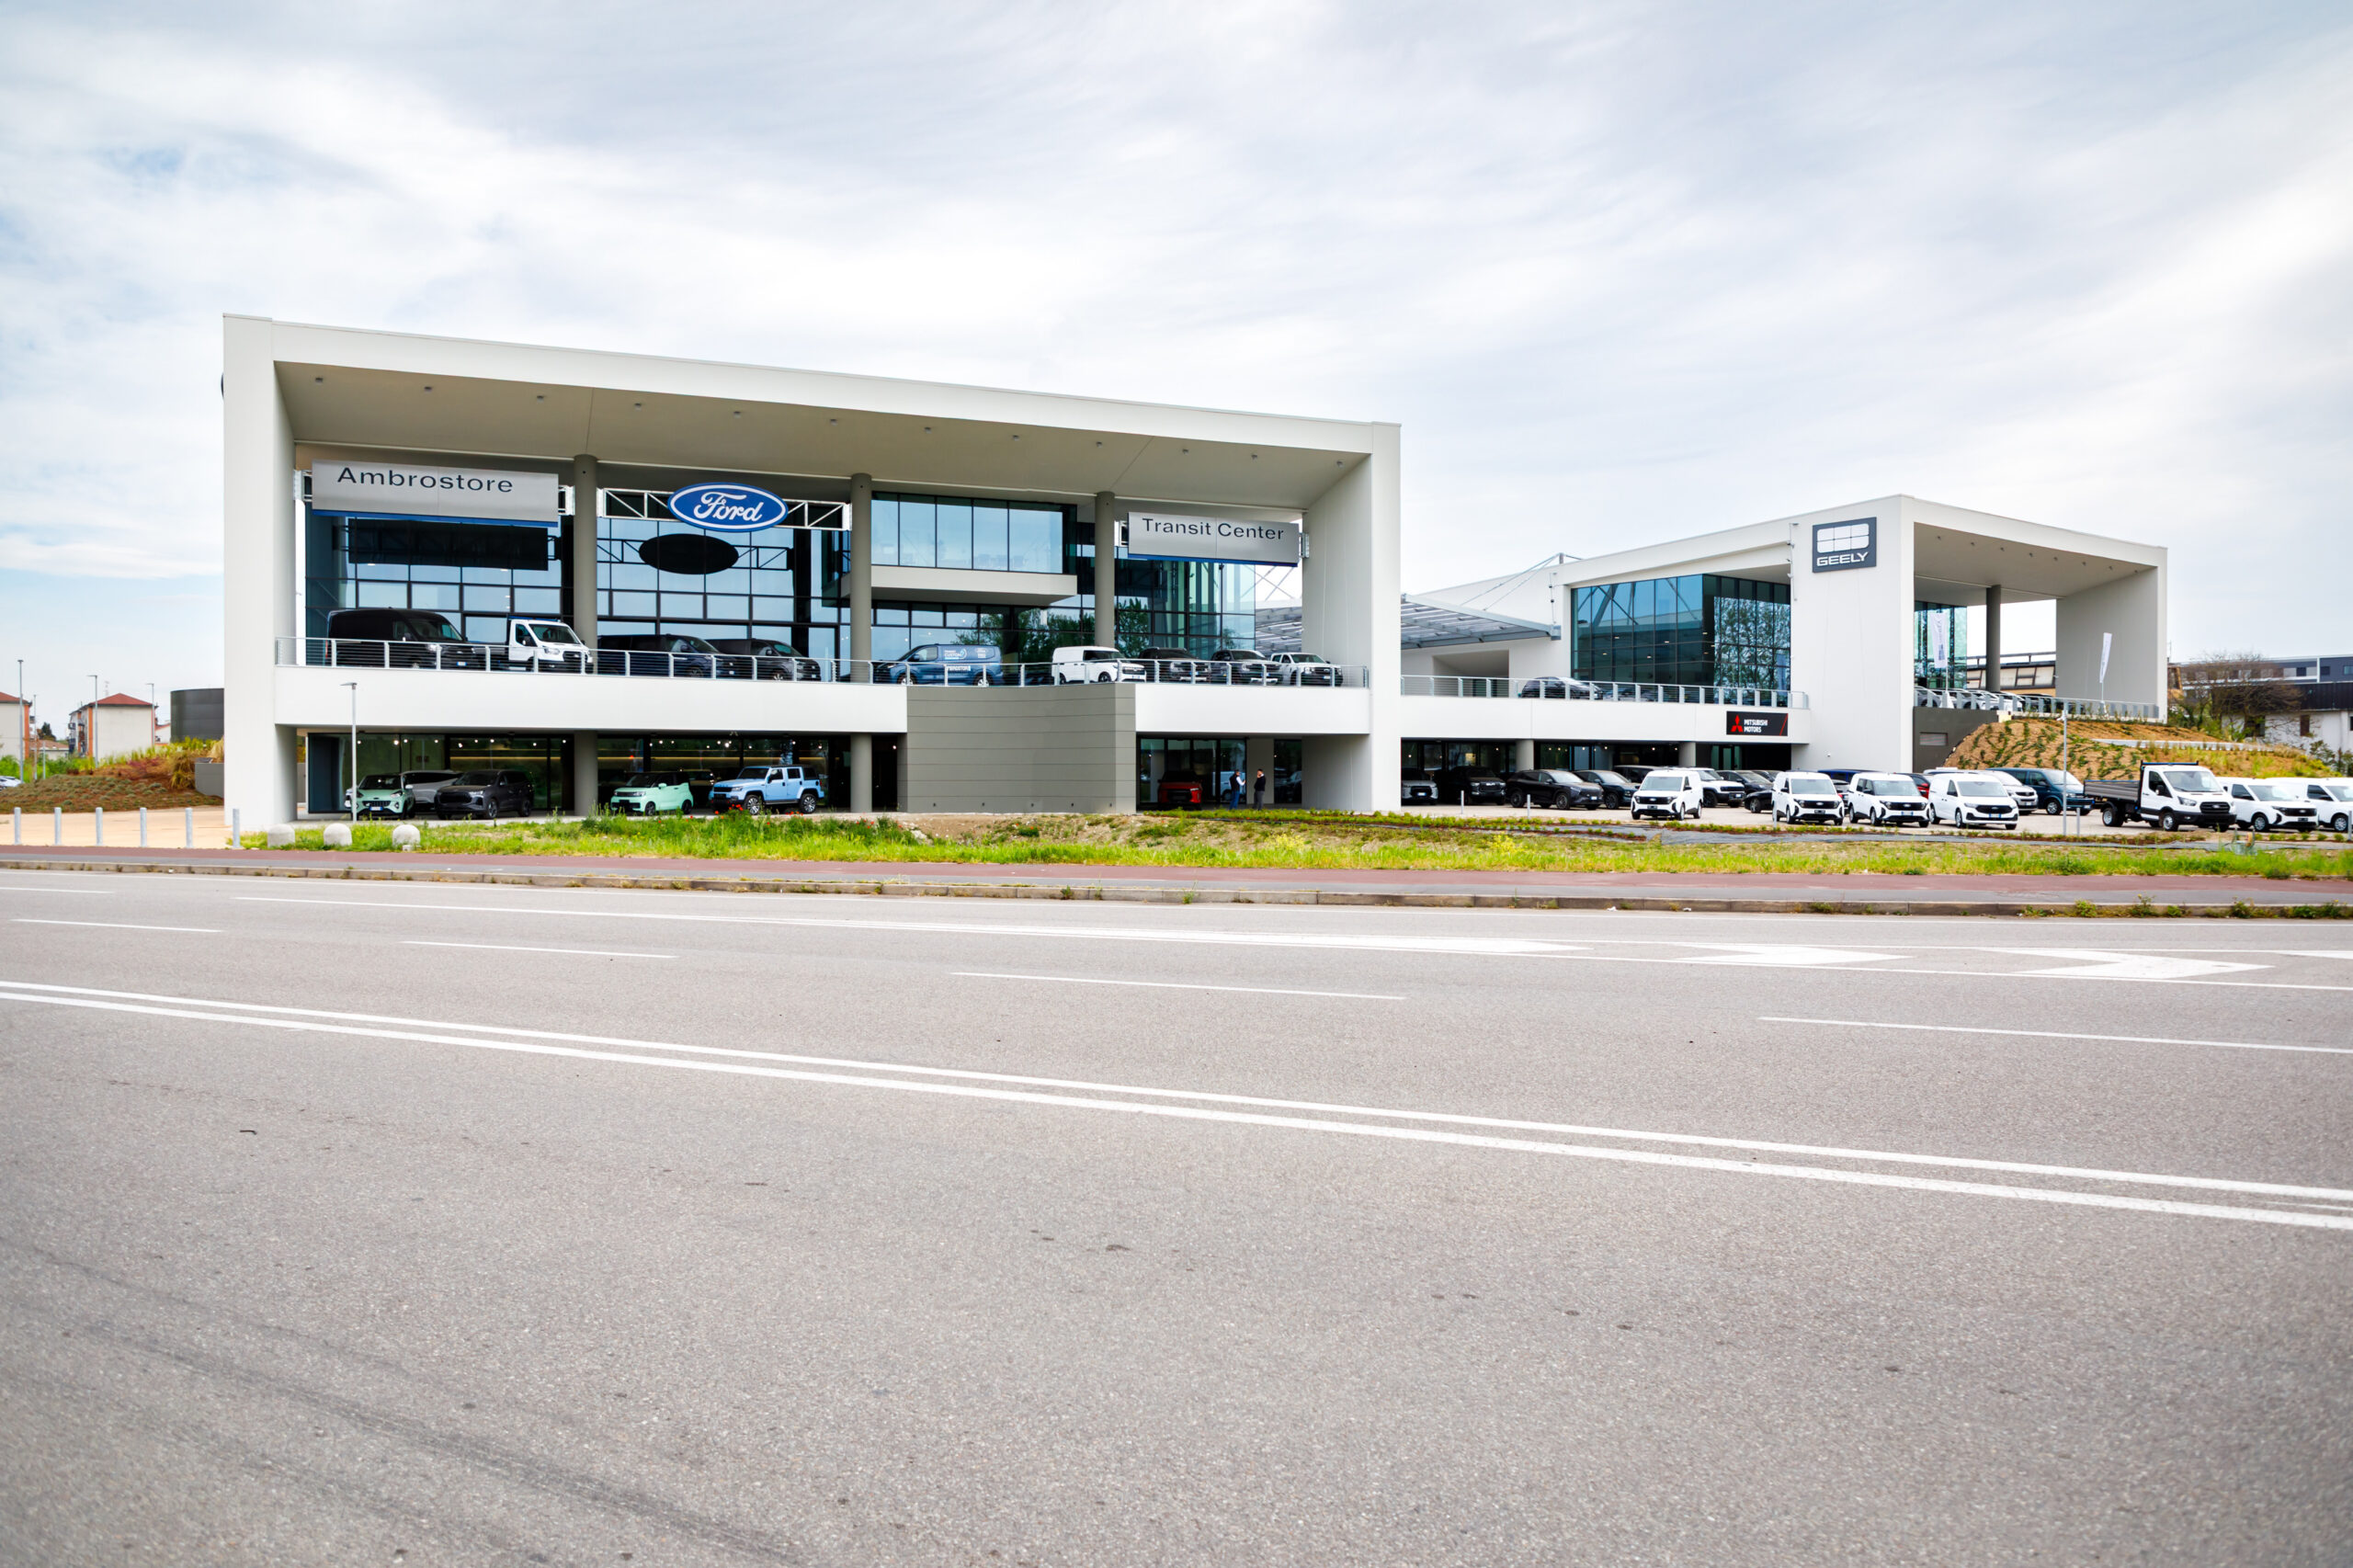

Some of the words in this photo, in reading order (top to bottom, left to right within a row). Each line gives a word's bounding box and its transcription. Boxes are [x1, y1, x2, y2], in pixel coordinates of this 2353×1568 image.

[337, 467, 513, 493] Ambrostore
[693, 491, 764, 522] Ford
[1142, 517, 1211, 536] Transit
[1218, 523, 1284, 540] Center
[1816, 551, 1869, 566] GEELY
